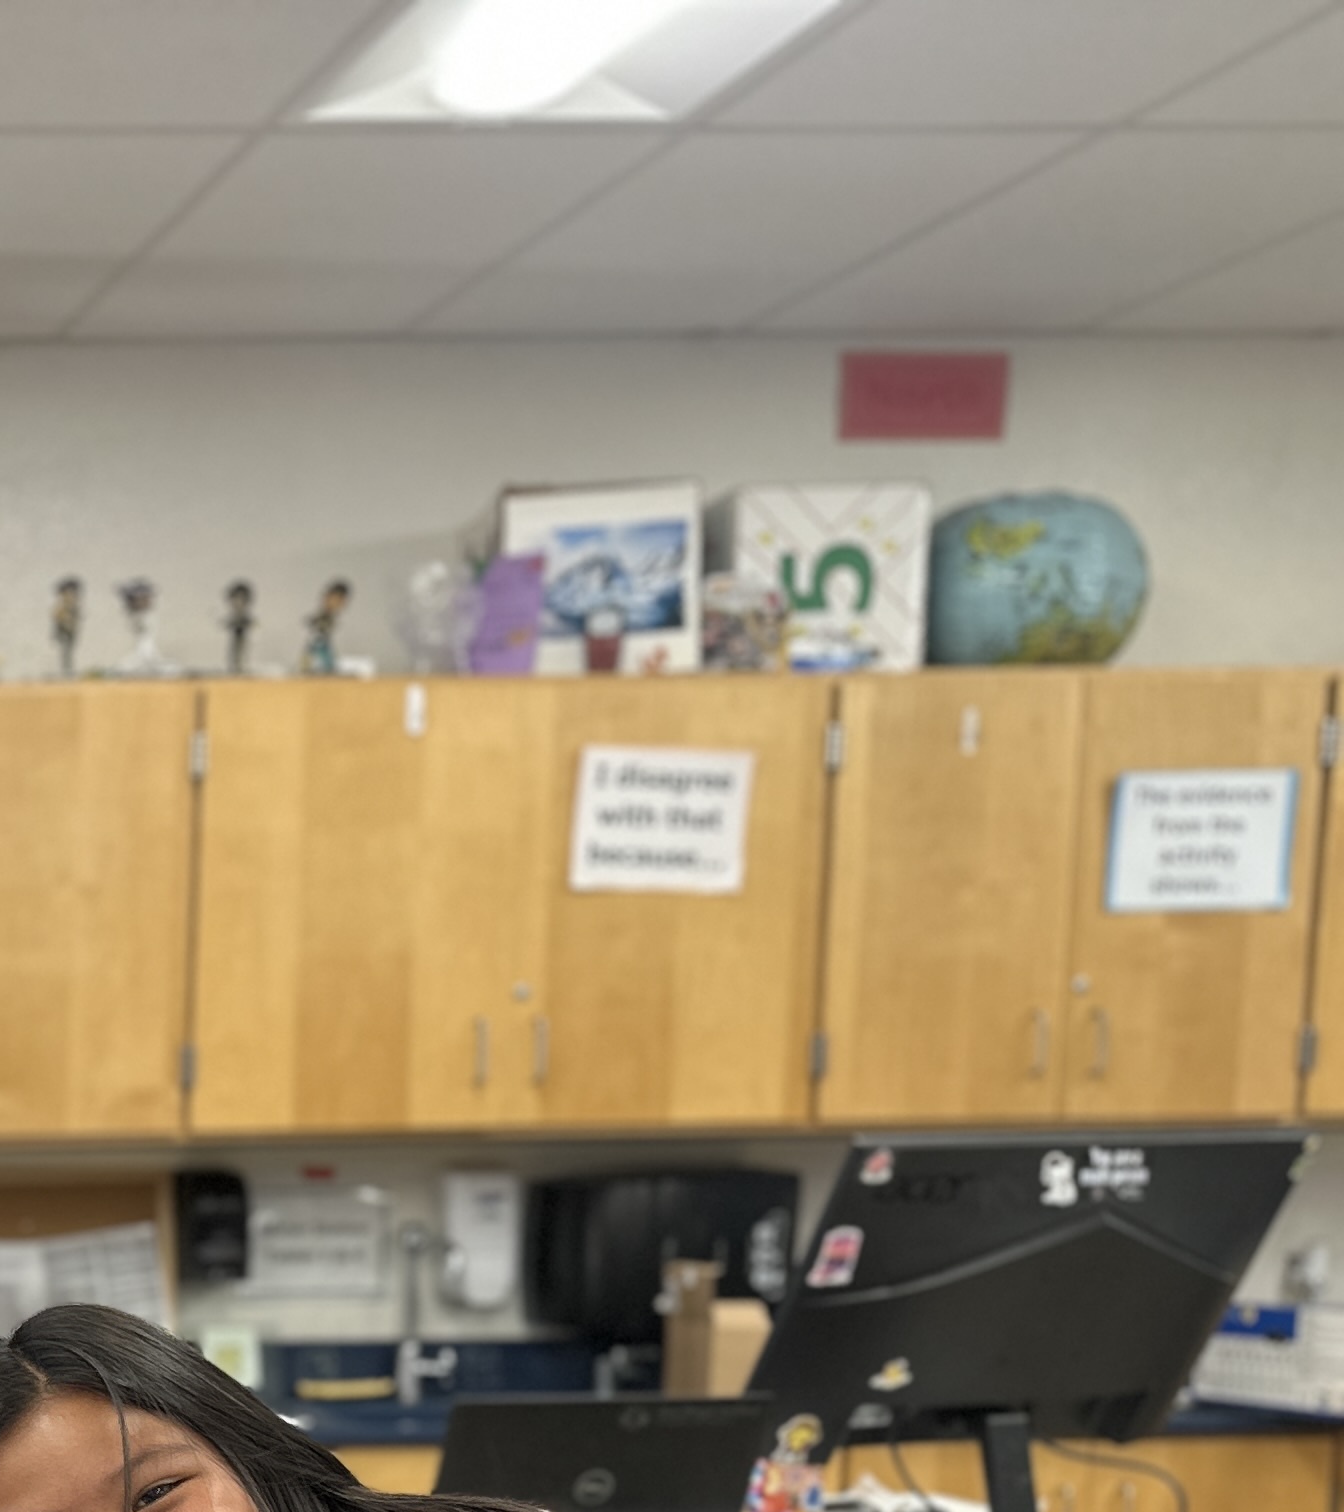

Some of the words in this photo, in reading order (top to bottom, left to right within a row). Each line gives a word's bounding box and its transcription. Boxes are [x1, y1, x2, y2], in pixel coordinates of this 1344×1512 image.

[782, 543, 872, 612] 5
[615, 762, 734, 798] disagree
[595, 801, 657, 833] with
[665, 802, 724, 835] that
